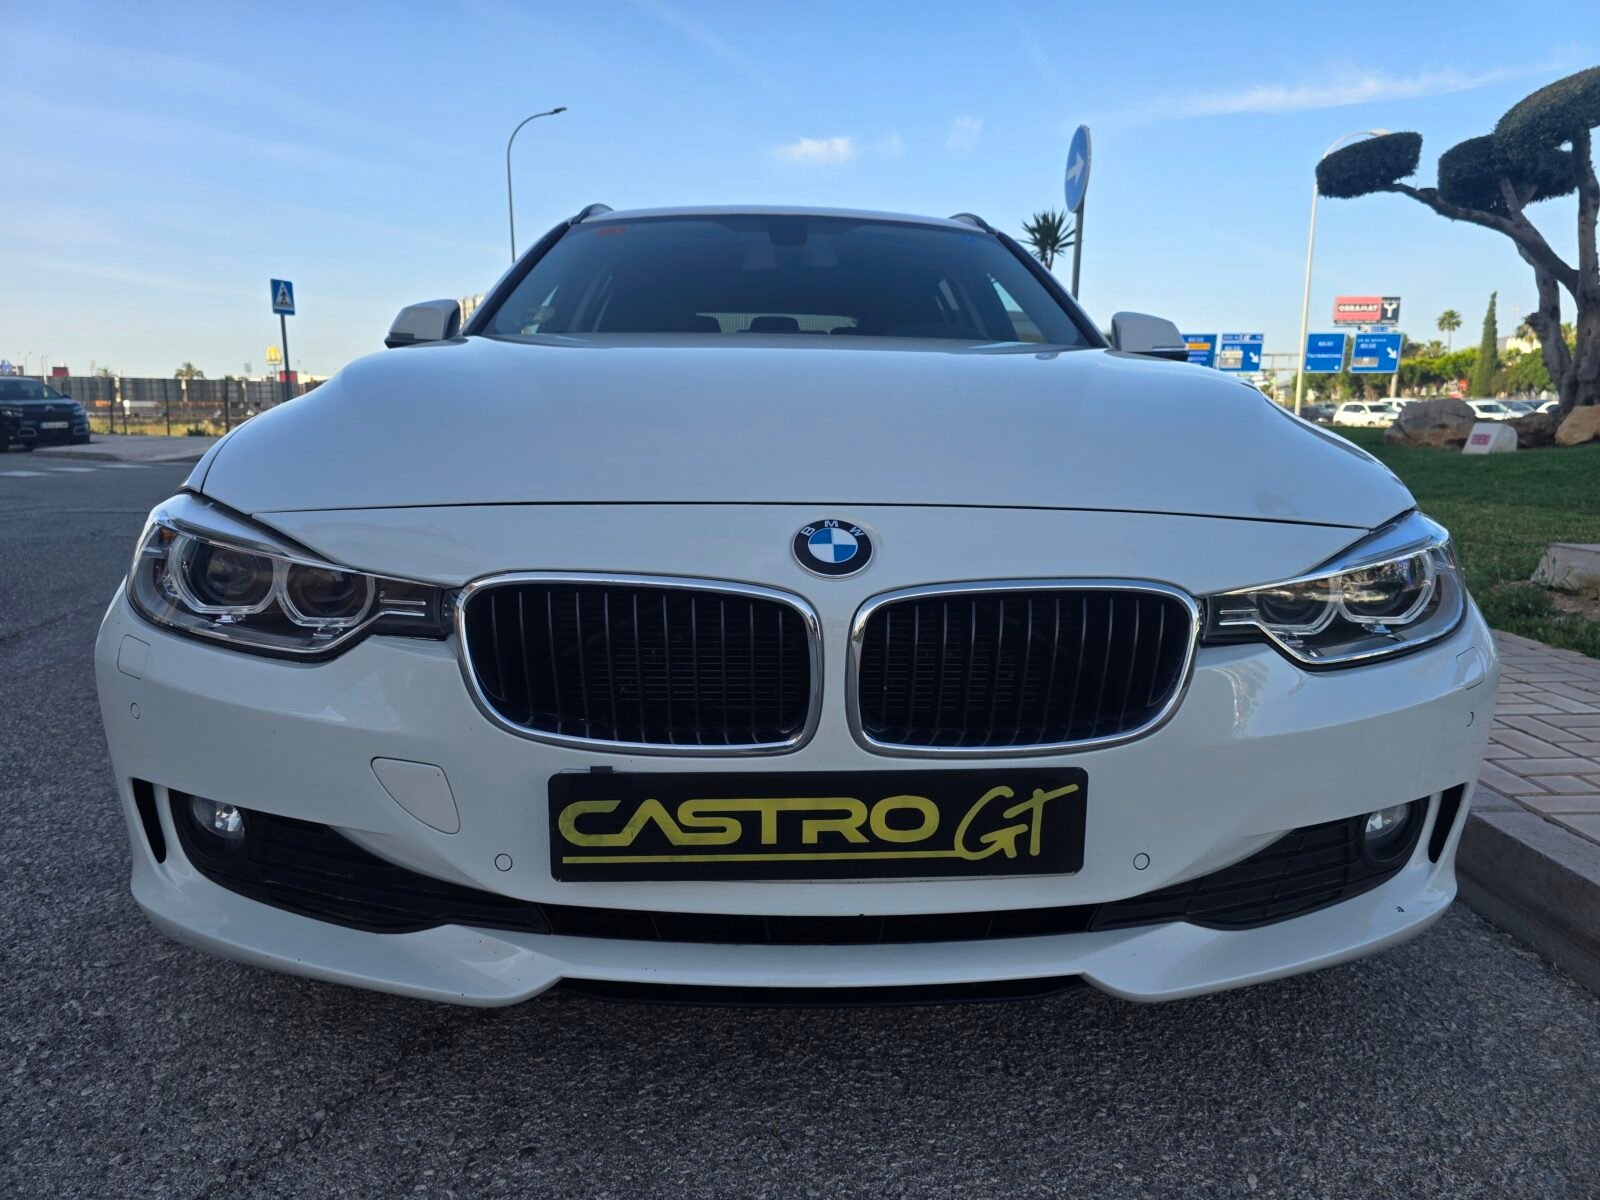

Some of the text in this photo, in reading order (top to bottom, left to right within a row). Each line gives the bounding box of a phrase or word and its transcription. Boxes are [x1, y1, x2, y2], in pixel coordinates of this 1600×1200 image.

[800, 520, 865, 537] BMW
[558, 783, 1078, 861] CASTRO GT
